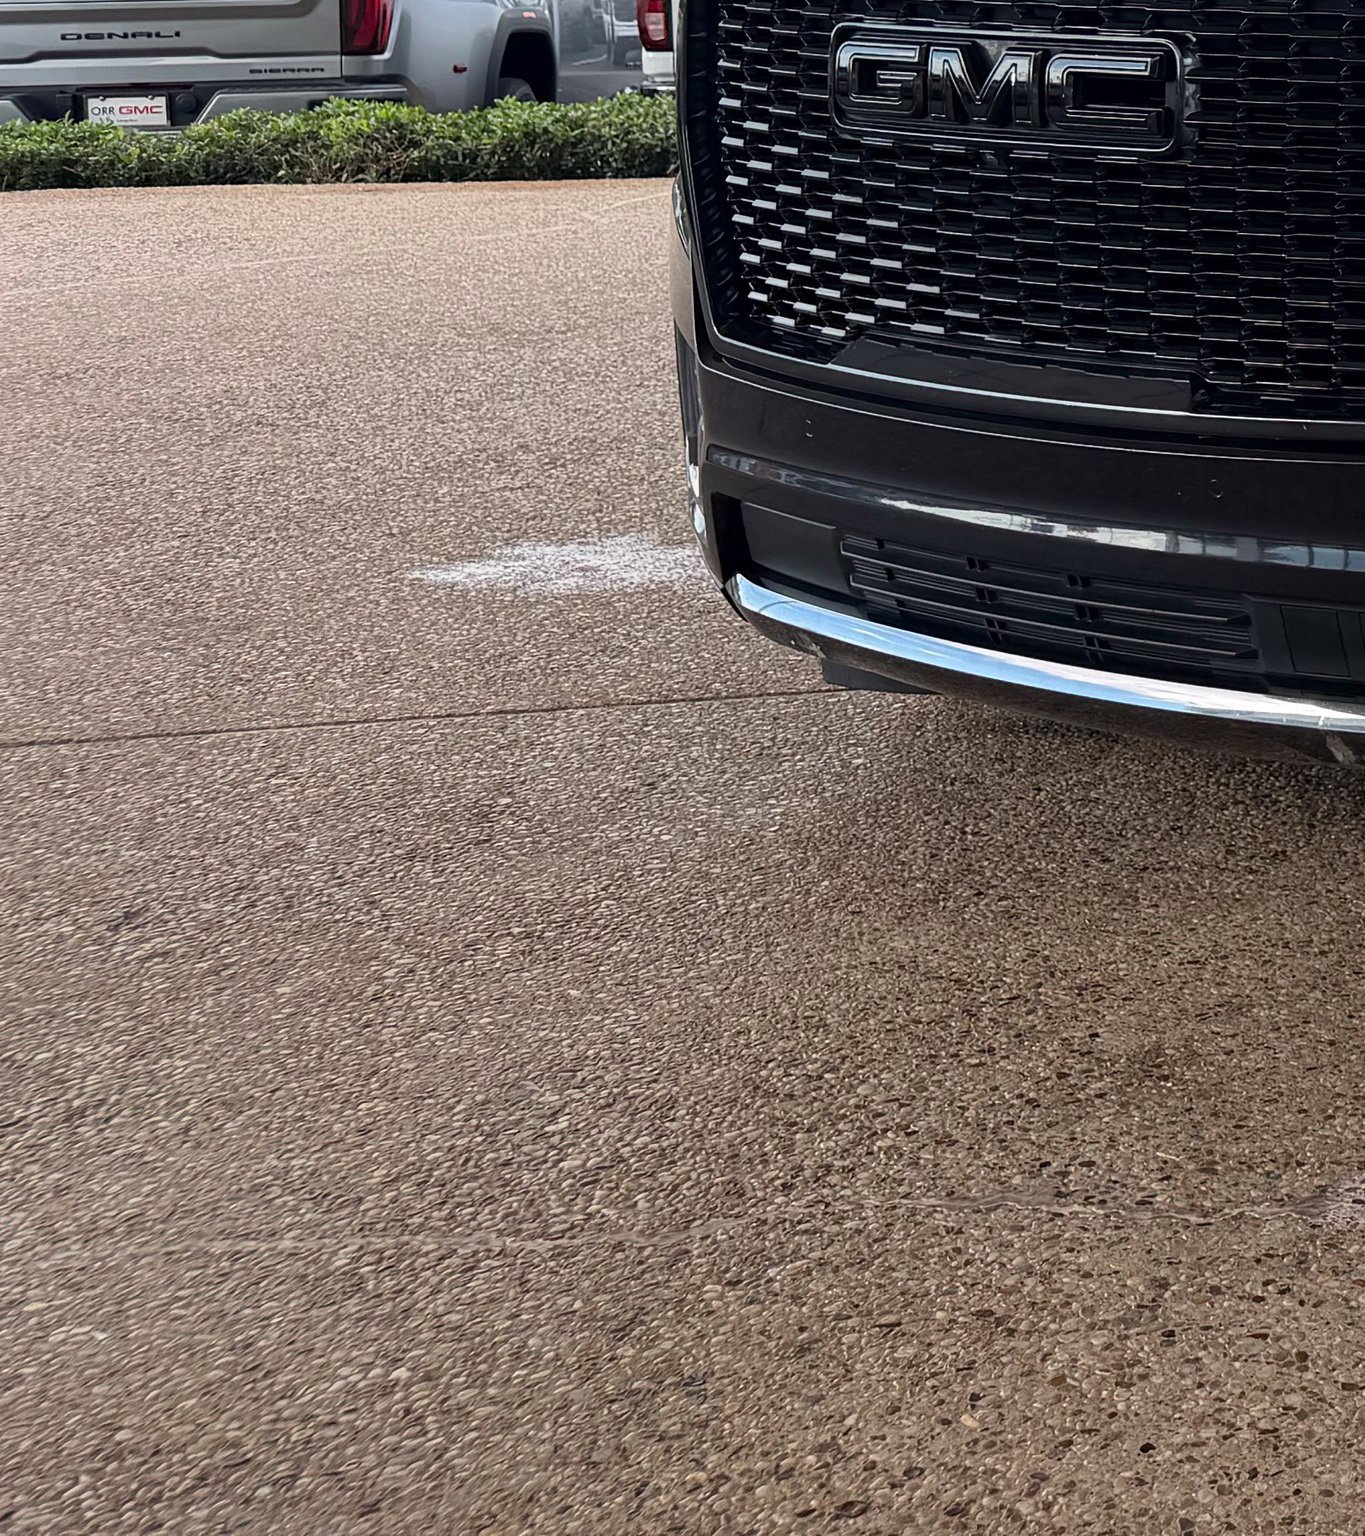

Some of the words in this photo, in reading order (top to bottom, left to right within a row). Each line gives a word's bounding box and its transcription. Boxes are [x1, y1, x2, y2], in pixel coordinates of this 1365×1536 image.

[60, 30, 180, 41] DENALI
[835, 40, 1166, 138] GMC
[91, 107, 115, 115] ORR
[119, 106, 163, 114] GMC
